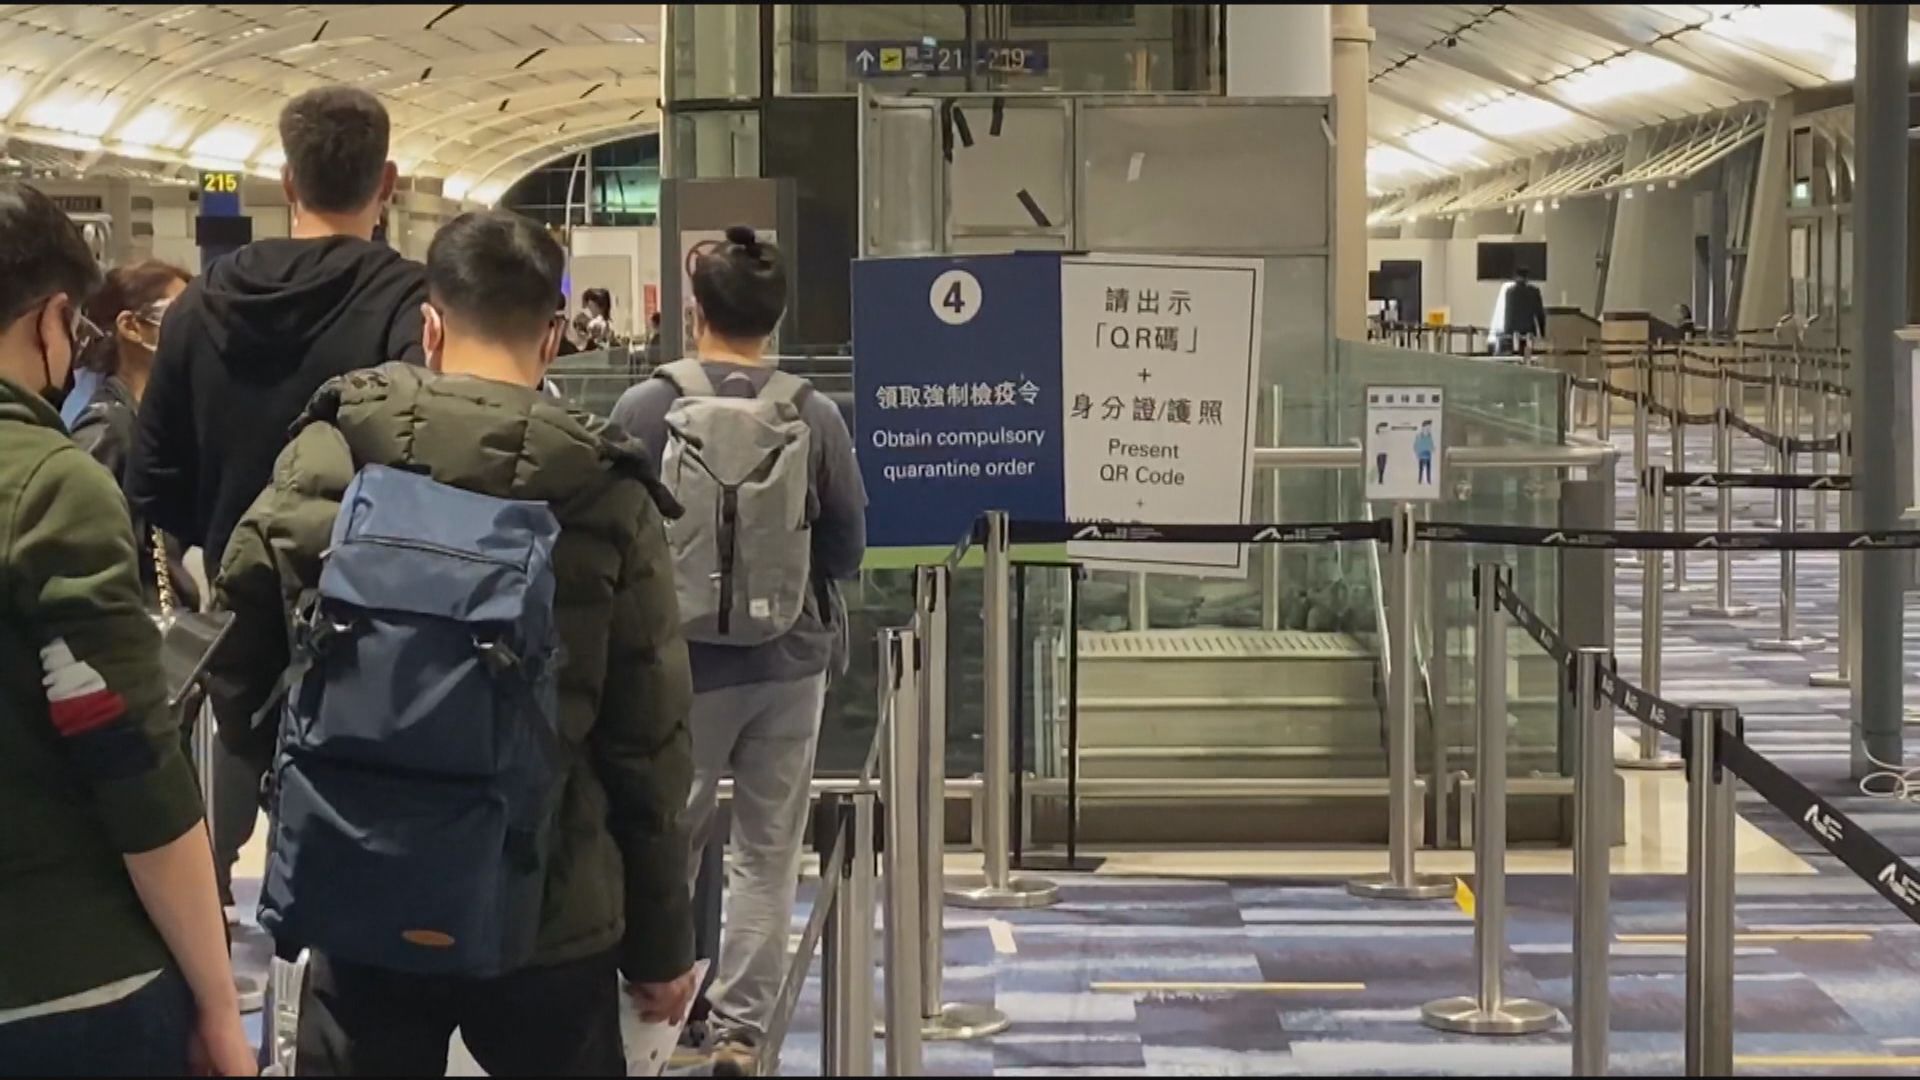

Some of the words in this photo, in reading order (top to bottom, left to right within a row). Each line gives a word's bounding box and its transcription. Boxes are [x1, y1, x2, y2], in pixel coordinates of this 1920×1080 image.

[204, 173, 238, 192] 215
[942, 280, 966, 314] 4
[1106, 286, 1192, 315] 請出示
[1096, 322, 1198, 354] 「QR碼」
[1138, 367, 1152, 383] +
[876, 380, 1041, 410] 領取強制檢疫令
[1071, 393, 1223, 425] 身分證/護照
[872, 430, 932, 448] Obtain
[937, 426, 1045, 447] compulsory
[1108, 439, 1180, 460] Present
[883, 461, 981, 481] quarantine
[986, 458, 1036, 477] order
[1099, 463, 1129, 483] QR
[1135, 465, 1185, 486] Code
